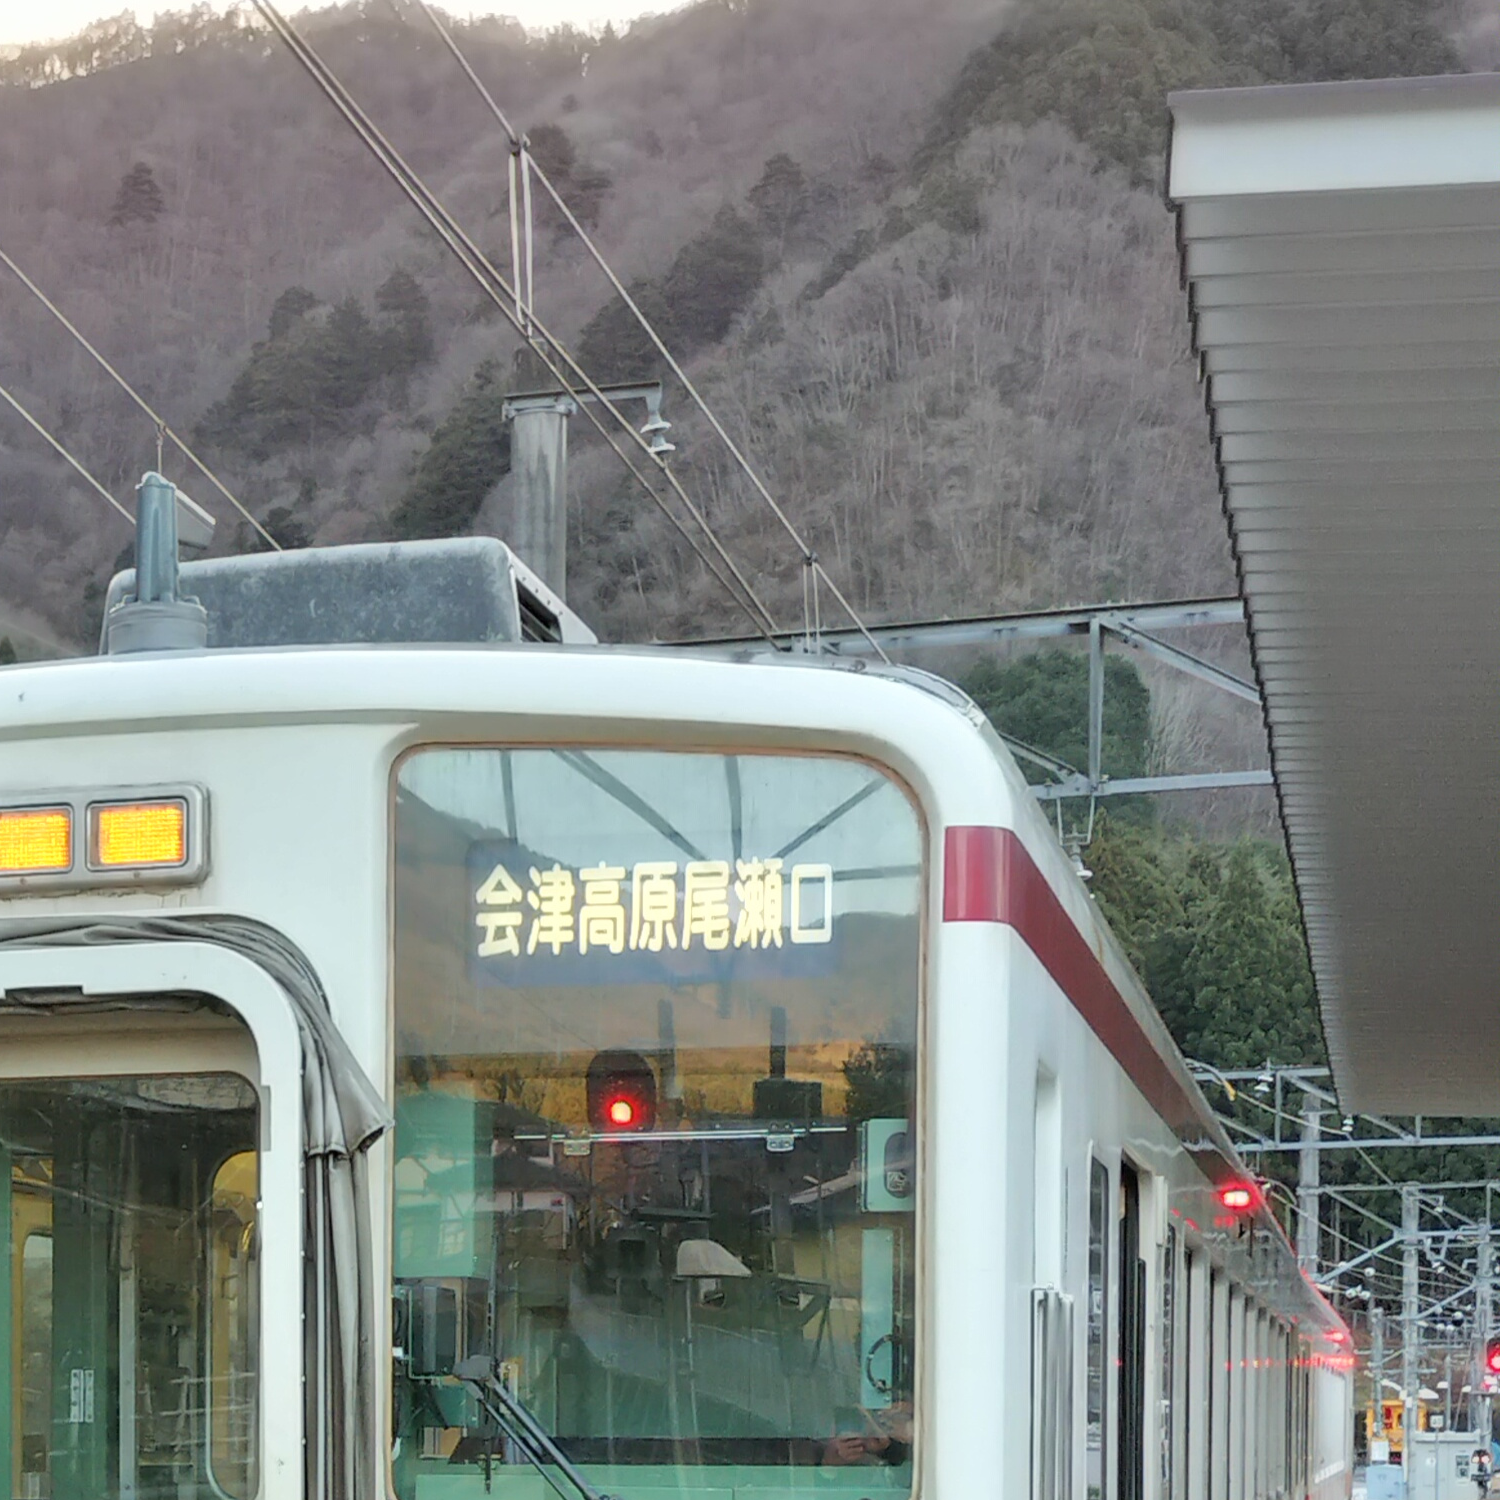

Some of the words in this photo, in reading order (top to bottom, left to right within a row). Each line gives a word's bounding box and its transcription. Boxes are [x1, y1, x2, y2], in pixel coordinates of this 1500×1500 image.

[475, 858, 832, 957] 会津高原尾瀬口
